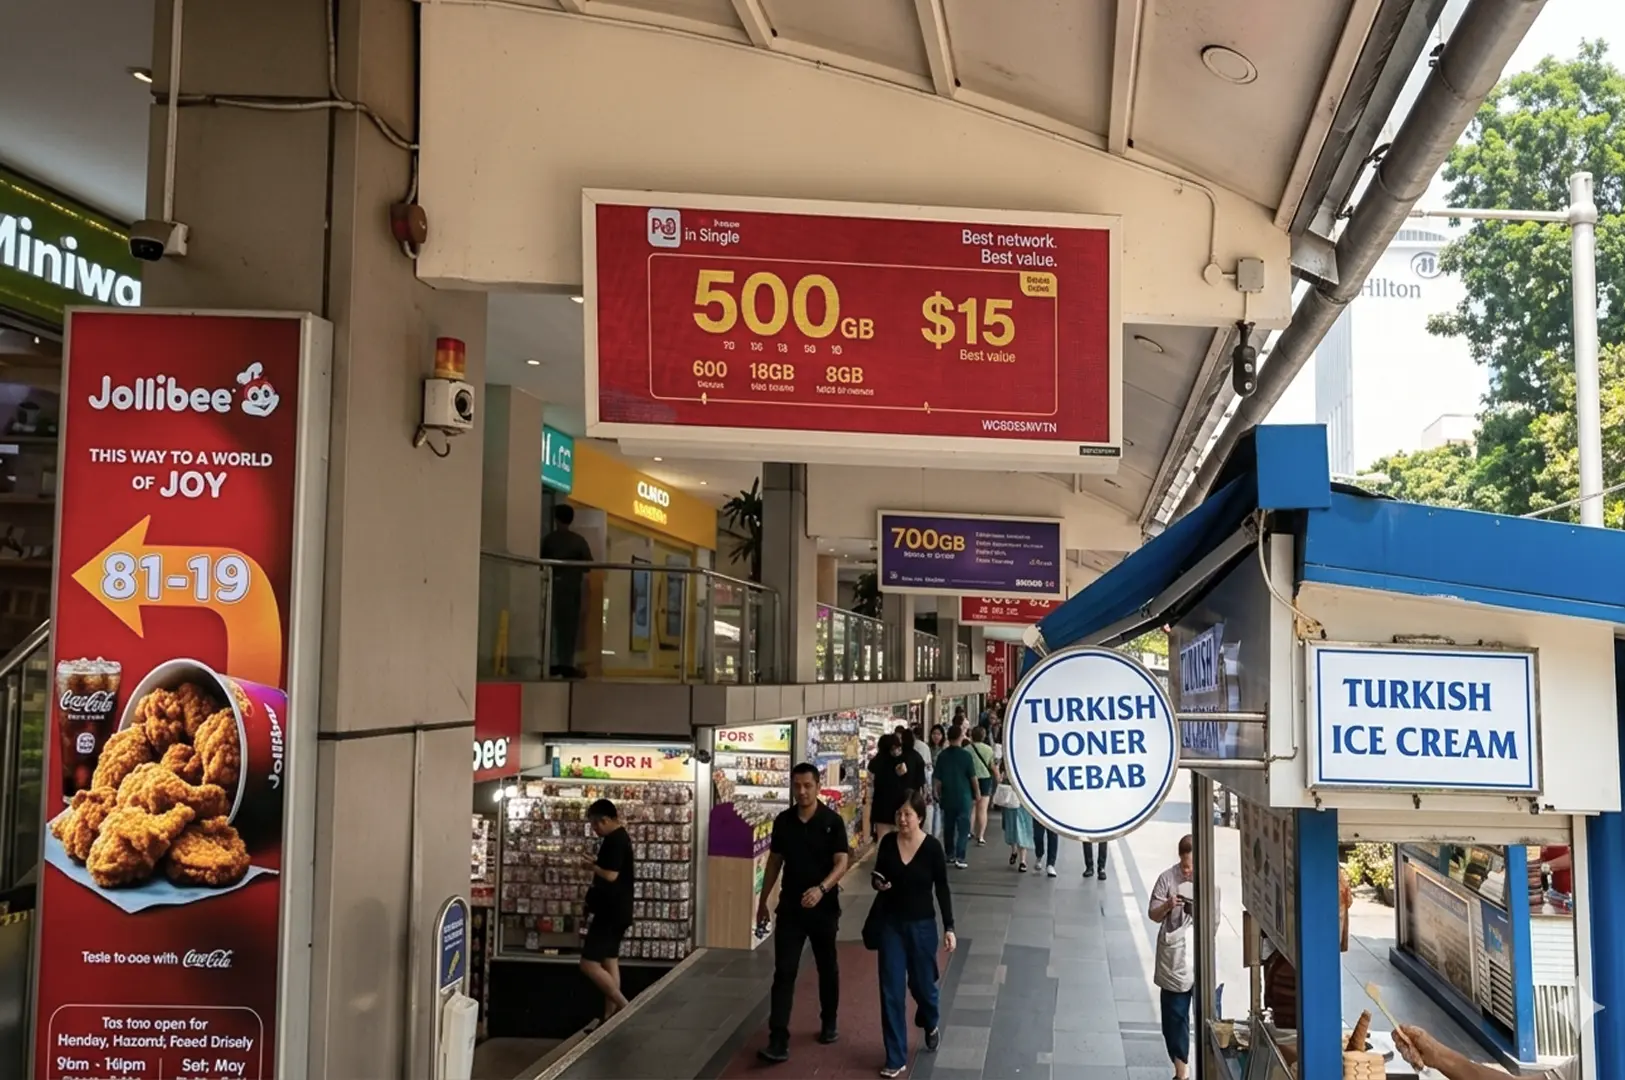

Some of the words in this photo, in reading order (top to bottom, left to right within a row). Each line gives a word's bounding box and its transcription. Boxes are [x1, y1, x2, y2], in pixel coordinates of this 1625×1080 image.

[685, 227, 697, 242] in
[699, 228, 740, 246] Single
[962, 229, 994, 247] Best
[997, 233, 1057, 249] network.
[981, 249, 1013, 265] Best
[1016, 252, 1058, 267] value.
[1361, 278, 1422, 298] Hilton
[921, 290, 1016, 350] $15
[960, 350, 984, 363] Best
[692, 359, 728, 378] 600
[749, 362, 795, 381] 18GB
[825, 366, 864, 384] 8GB
[88, 374, 233, 413] Jollibee
[89, 448, 127, 463] THIS
[130, 449, 167, 464] WAY
[170, 450, 193, 465] TO
[198, 451, 209, 466] A
[212, 451, 273, 467] WORLD
[132, 475, 155, 490] OF
[159, 470, 228, 499] JOY
[890, 526, 966, 552] 700GB
[100, 551, 252, 604] 81-19
[1342, 678, 1492, 712] TURKISH
[1024, 695, 1157, 724] TURKISH
[1038, 729, 1147, 757] DONER
[1332, 725, 1387, 755] ICE
[1396, 727, 1519, 760] CREAM
[604, 755, 636, 768] FOR
[1046, 764, 1146, 792] KEBAB
[153, 953, 178, 965] with
[154, 1019, 186, 1032] open
[189, 1017, 208, 1030] for
